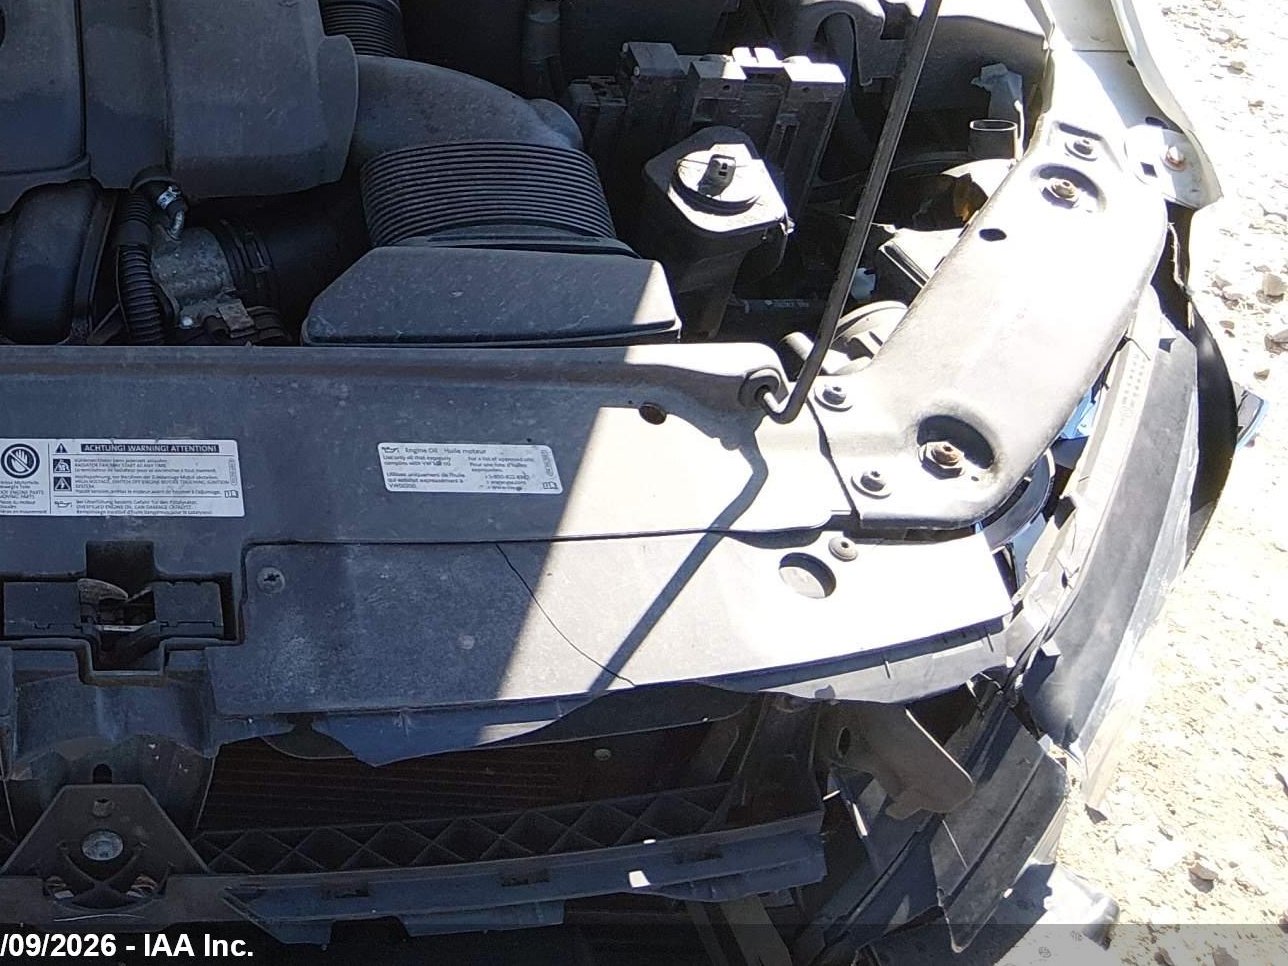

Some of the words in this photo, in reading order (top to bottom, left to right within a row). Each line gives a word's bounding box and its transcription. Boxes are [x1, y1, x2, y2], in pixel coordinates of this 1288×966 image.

[84, 444, 126, 452] ACHTUNG!
[127, 444, 169, 452] WARNING!
[171, 444, 217, 453] ATTENTION!
